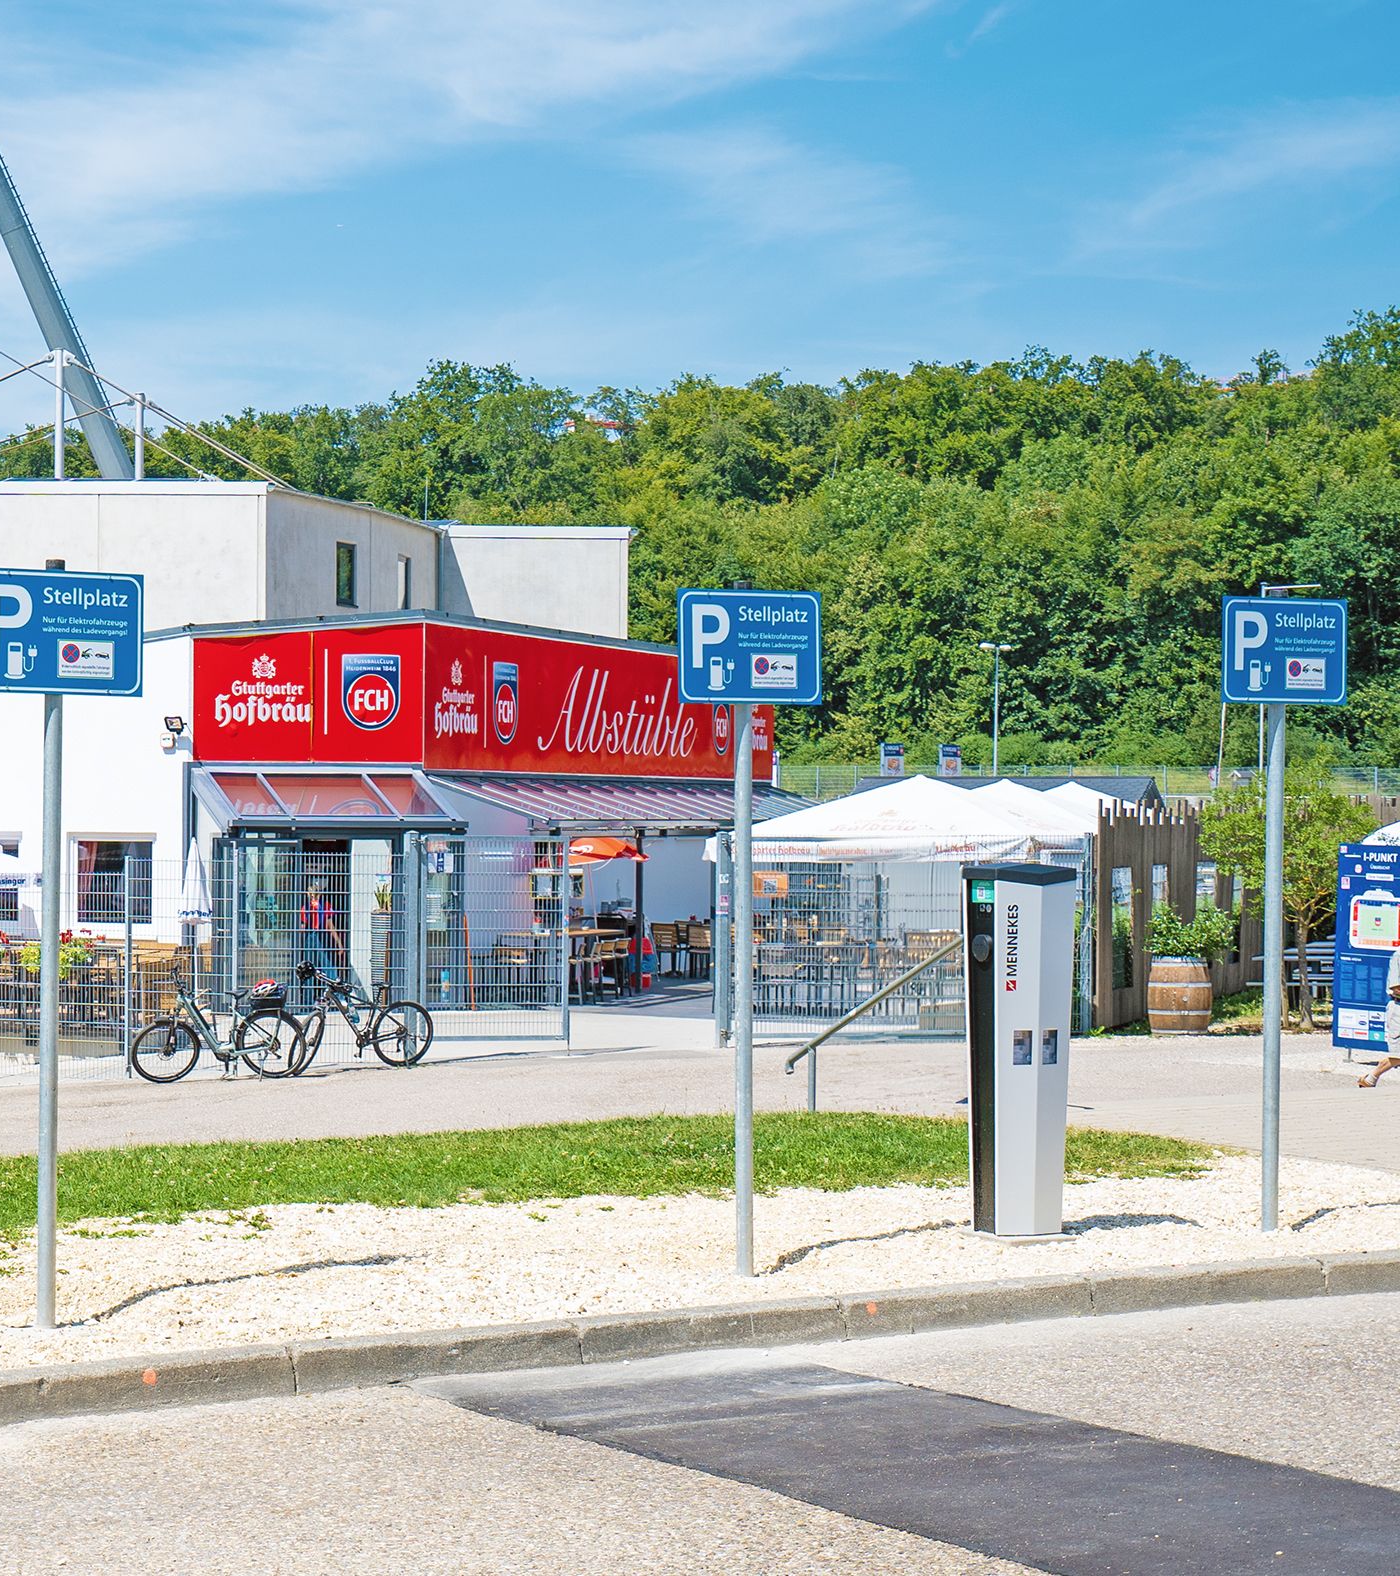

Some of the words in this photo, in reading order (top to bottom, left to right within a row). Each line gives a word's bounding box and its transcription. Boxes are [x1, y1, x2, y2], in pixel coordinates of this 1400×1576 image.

[43, 587, 128, 609] Stellplatz
[57, 616, 68, 624] für
[69, 617, 128, 627] Elektrofahrzeuge
[738, 606, 808, 626] Stellplatz
[1275, 613, 1336, 631] Stellplatz
[42, 626, 71, 634] während
[71, 626, 82, 634] des
[83, 627, 128, 636] Ladevorgangs!
[692, 603, 730, 668] P
[750, 632, 759, 640] für
[760, 633, 808, 641] Elektrofahrzeuge
[1234, 610, 1268, 671] P
[231, 680, 304, 699] Stuttgarter
[354, 689, 389, 711] FCH
[442, 686, 475, 706] Stuttgarter
[214, 693, 312, 728] Hofbräu
[434, 702, 478, 739] Hofbräu
[498, 700, 514, 723] FCH
[537, 665, 698, 757] Albstüble
[715, 718, 728, 738] FCH
[1363, 852, 1398, 863] I-PUNKT
[1006, 903, 1019, 977] MENNEKES
